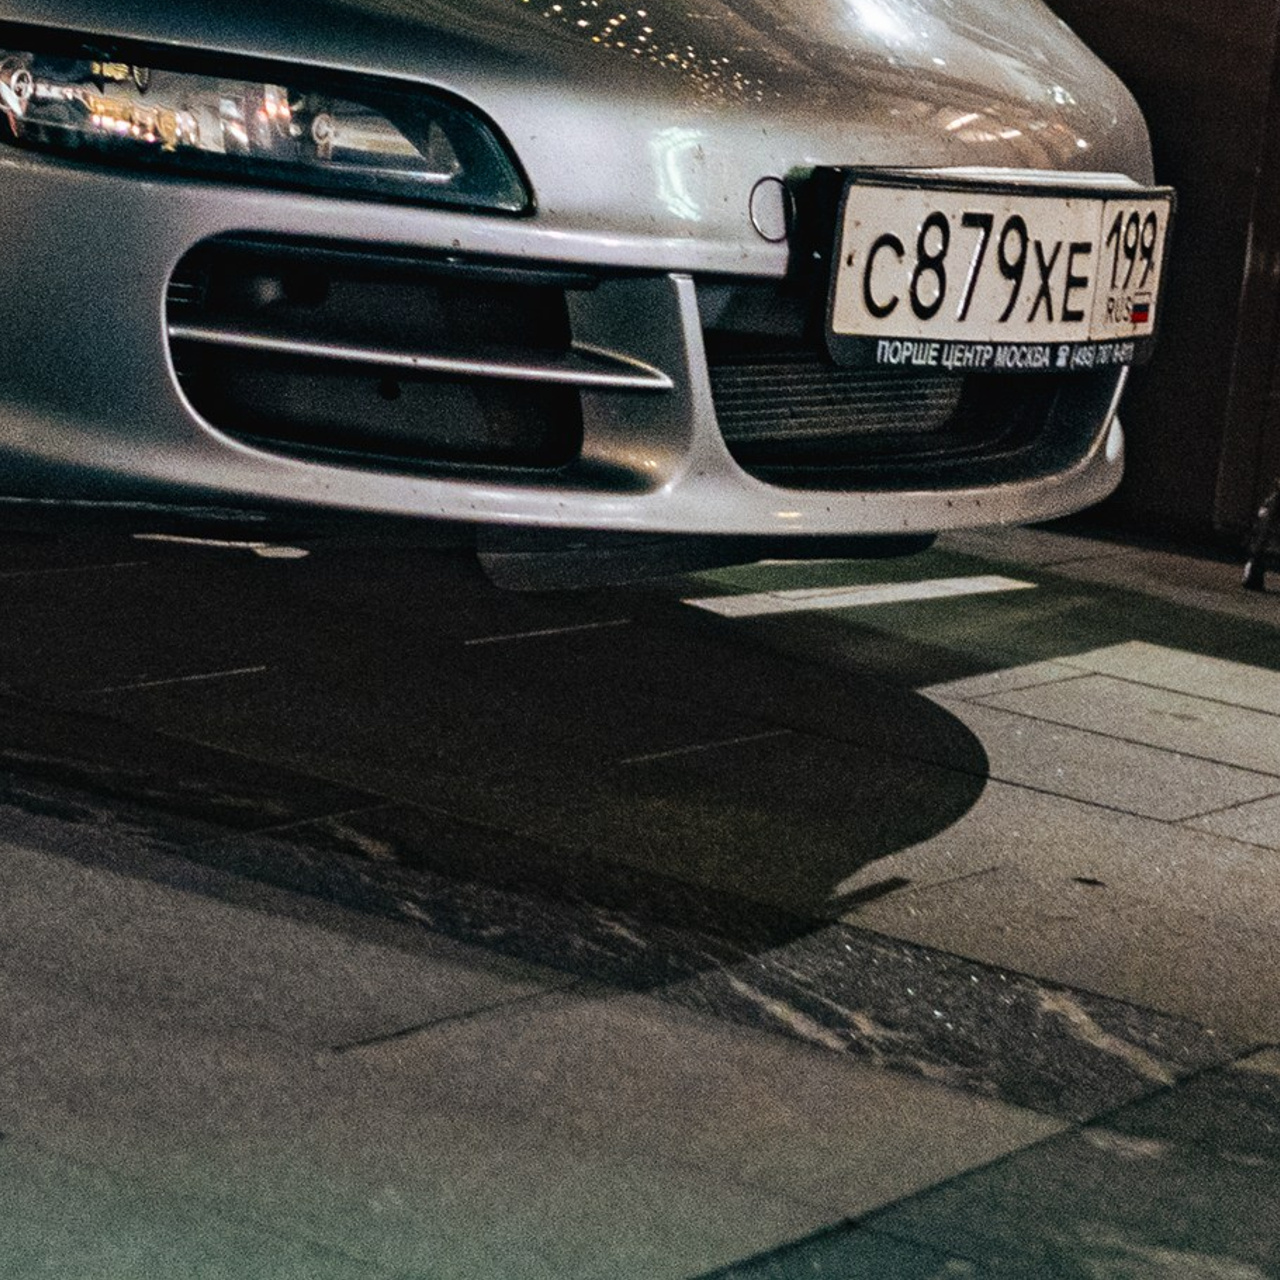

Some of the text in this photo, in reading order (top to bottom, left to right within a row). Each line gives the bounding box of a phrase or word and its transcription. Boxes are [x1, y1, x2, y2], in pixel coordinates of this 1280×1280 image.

[1105, 209, 1158, 290] 199
[1105, 296, 1132, 324] RUS
[876, 339, 941, 366] ПОРШЕ
[941, 342, 993, 370] ЦЕНТР
[994, 343, 1051, 369] МОСКВА
